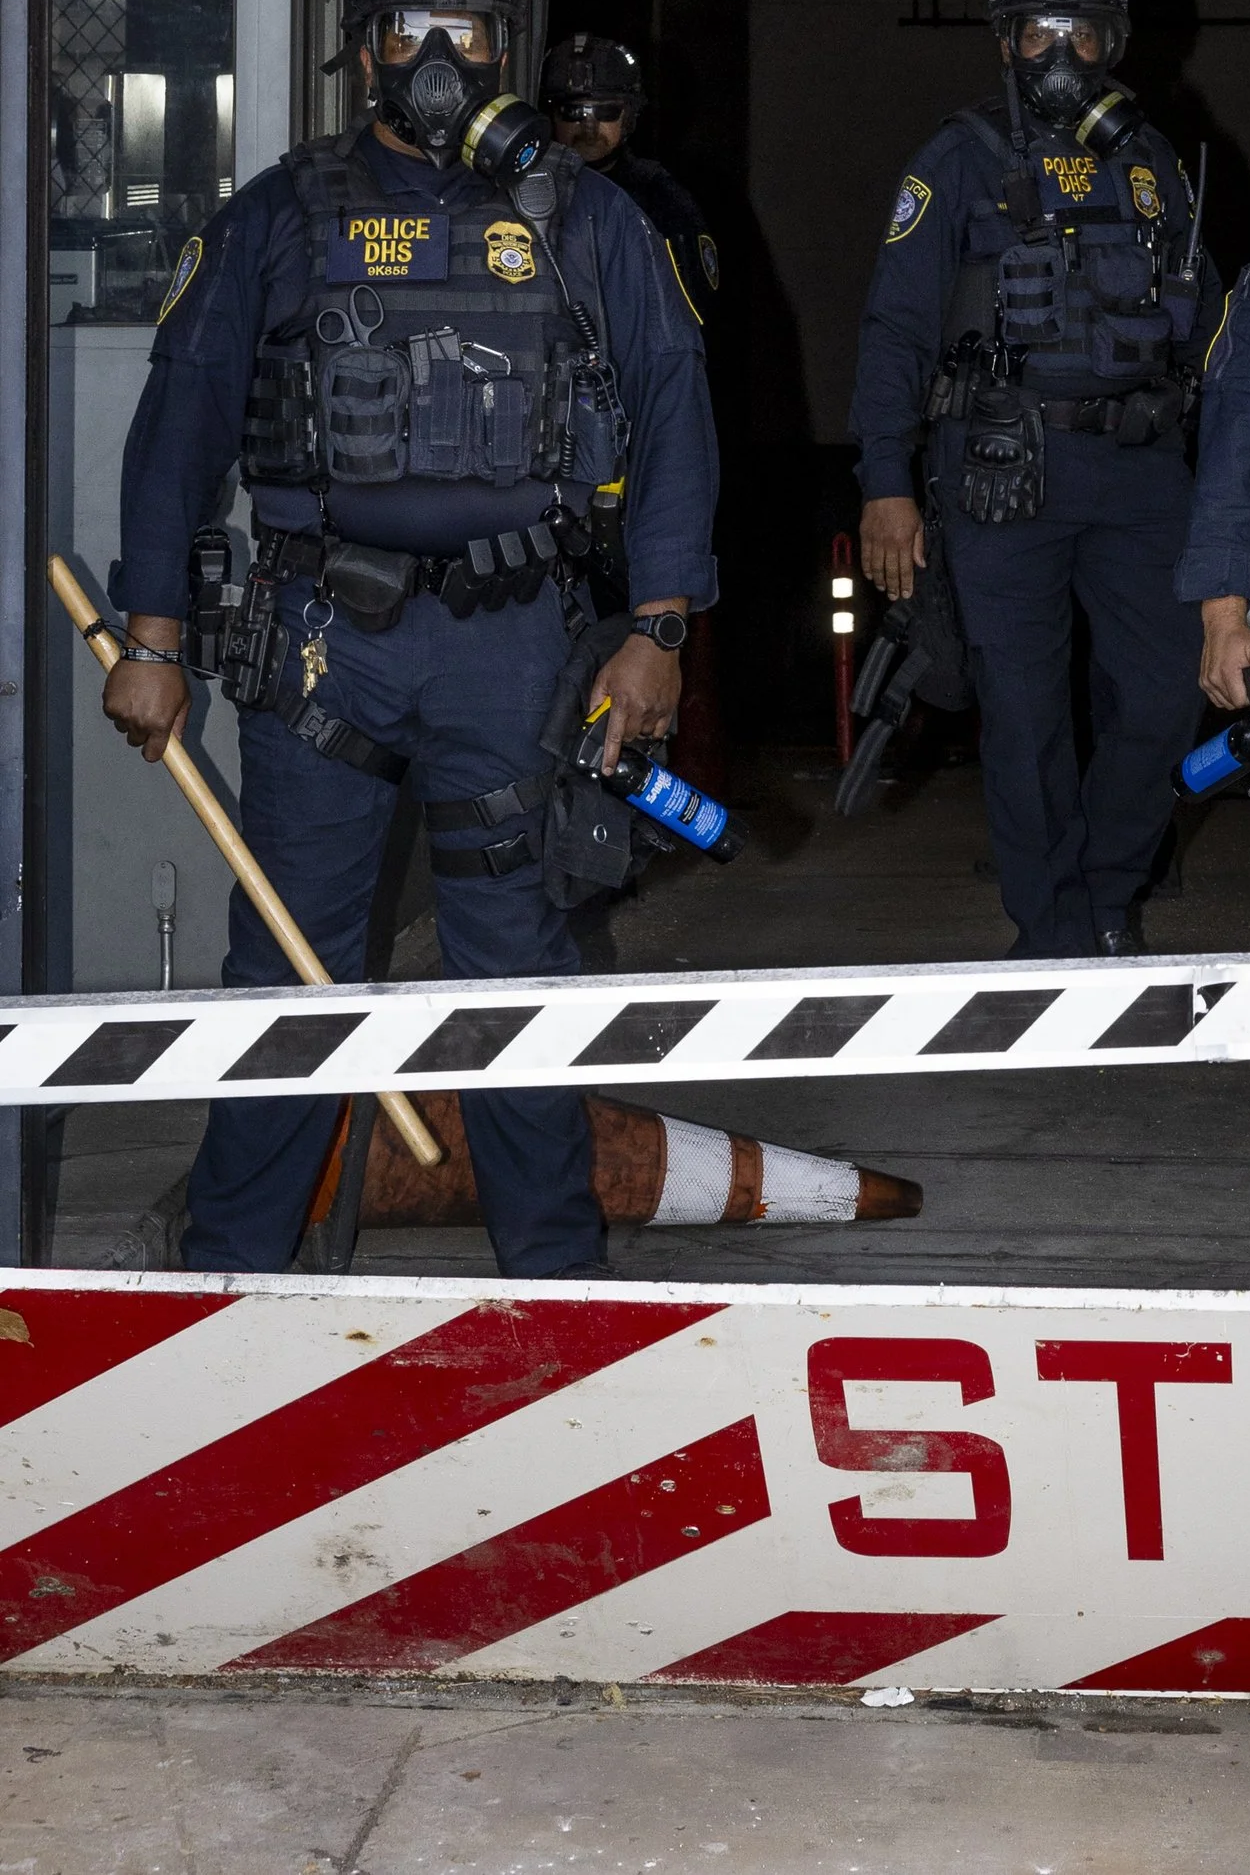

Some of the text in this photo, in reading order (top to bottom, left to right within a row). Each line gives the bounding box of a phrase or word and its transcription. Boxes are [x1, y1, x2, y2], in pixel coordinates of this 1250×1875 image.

[1043, 157, 1098, 176] POLICE
[1057, 174, 1093, 194] DHS
[348, 217, 431, 240] POLICE
[363, 240, 413, 263] DHS
[367, 265, 409, 276] 9K855
